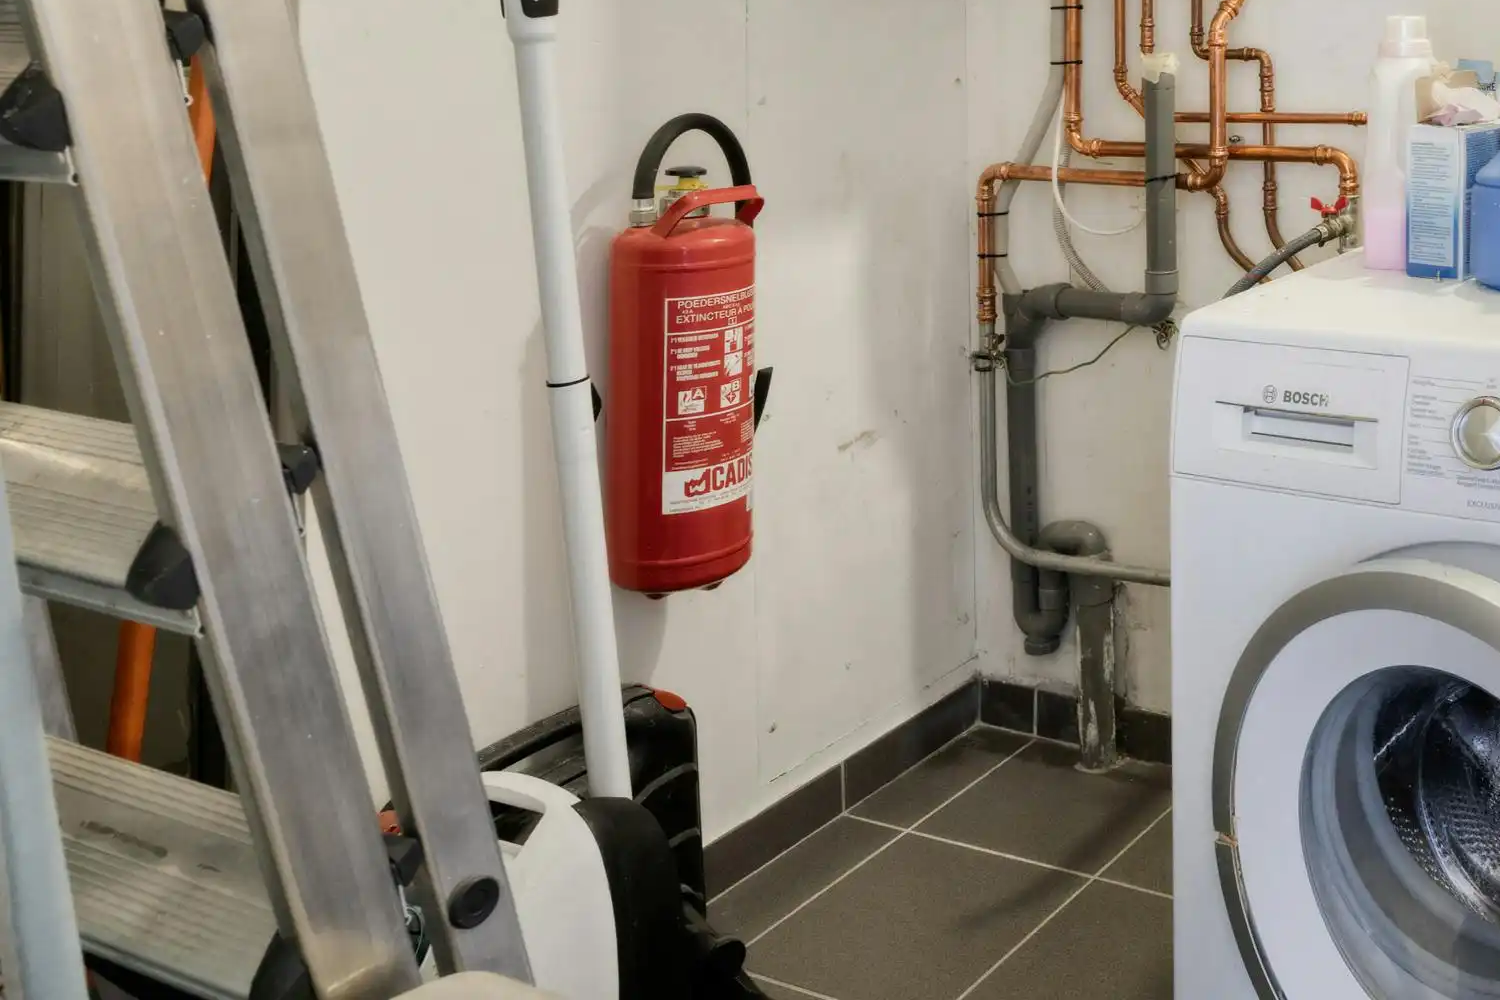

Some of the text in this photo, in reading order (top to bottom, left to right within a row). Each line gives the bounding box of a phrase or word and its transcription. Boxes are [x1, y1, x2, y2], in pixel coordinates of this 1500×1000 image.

[676, 308, 737, 325] EXTINCTEUR
[692, 388, 705, 400] A
[1283, 390, 1330, 408] BOSCH
